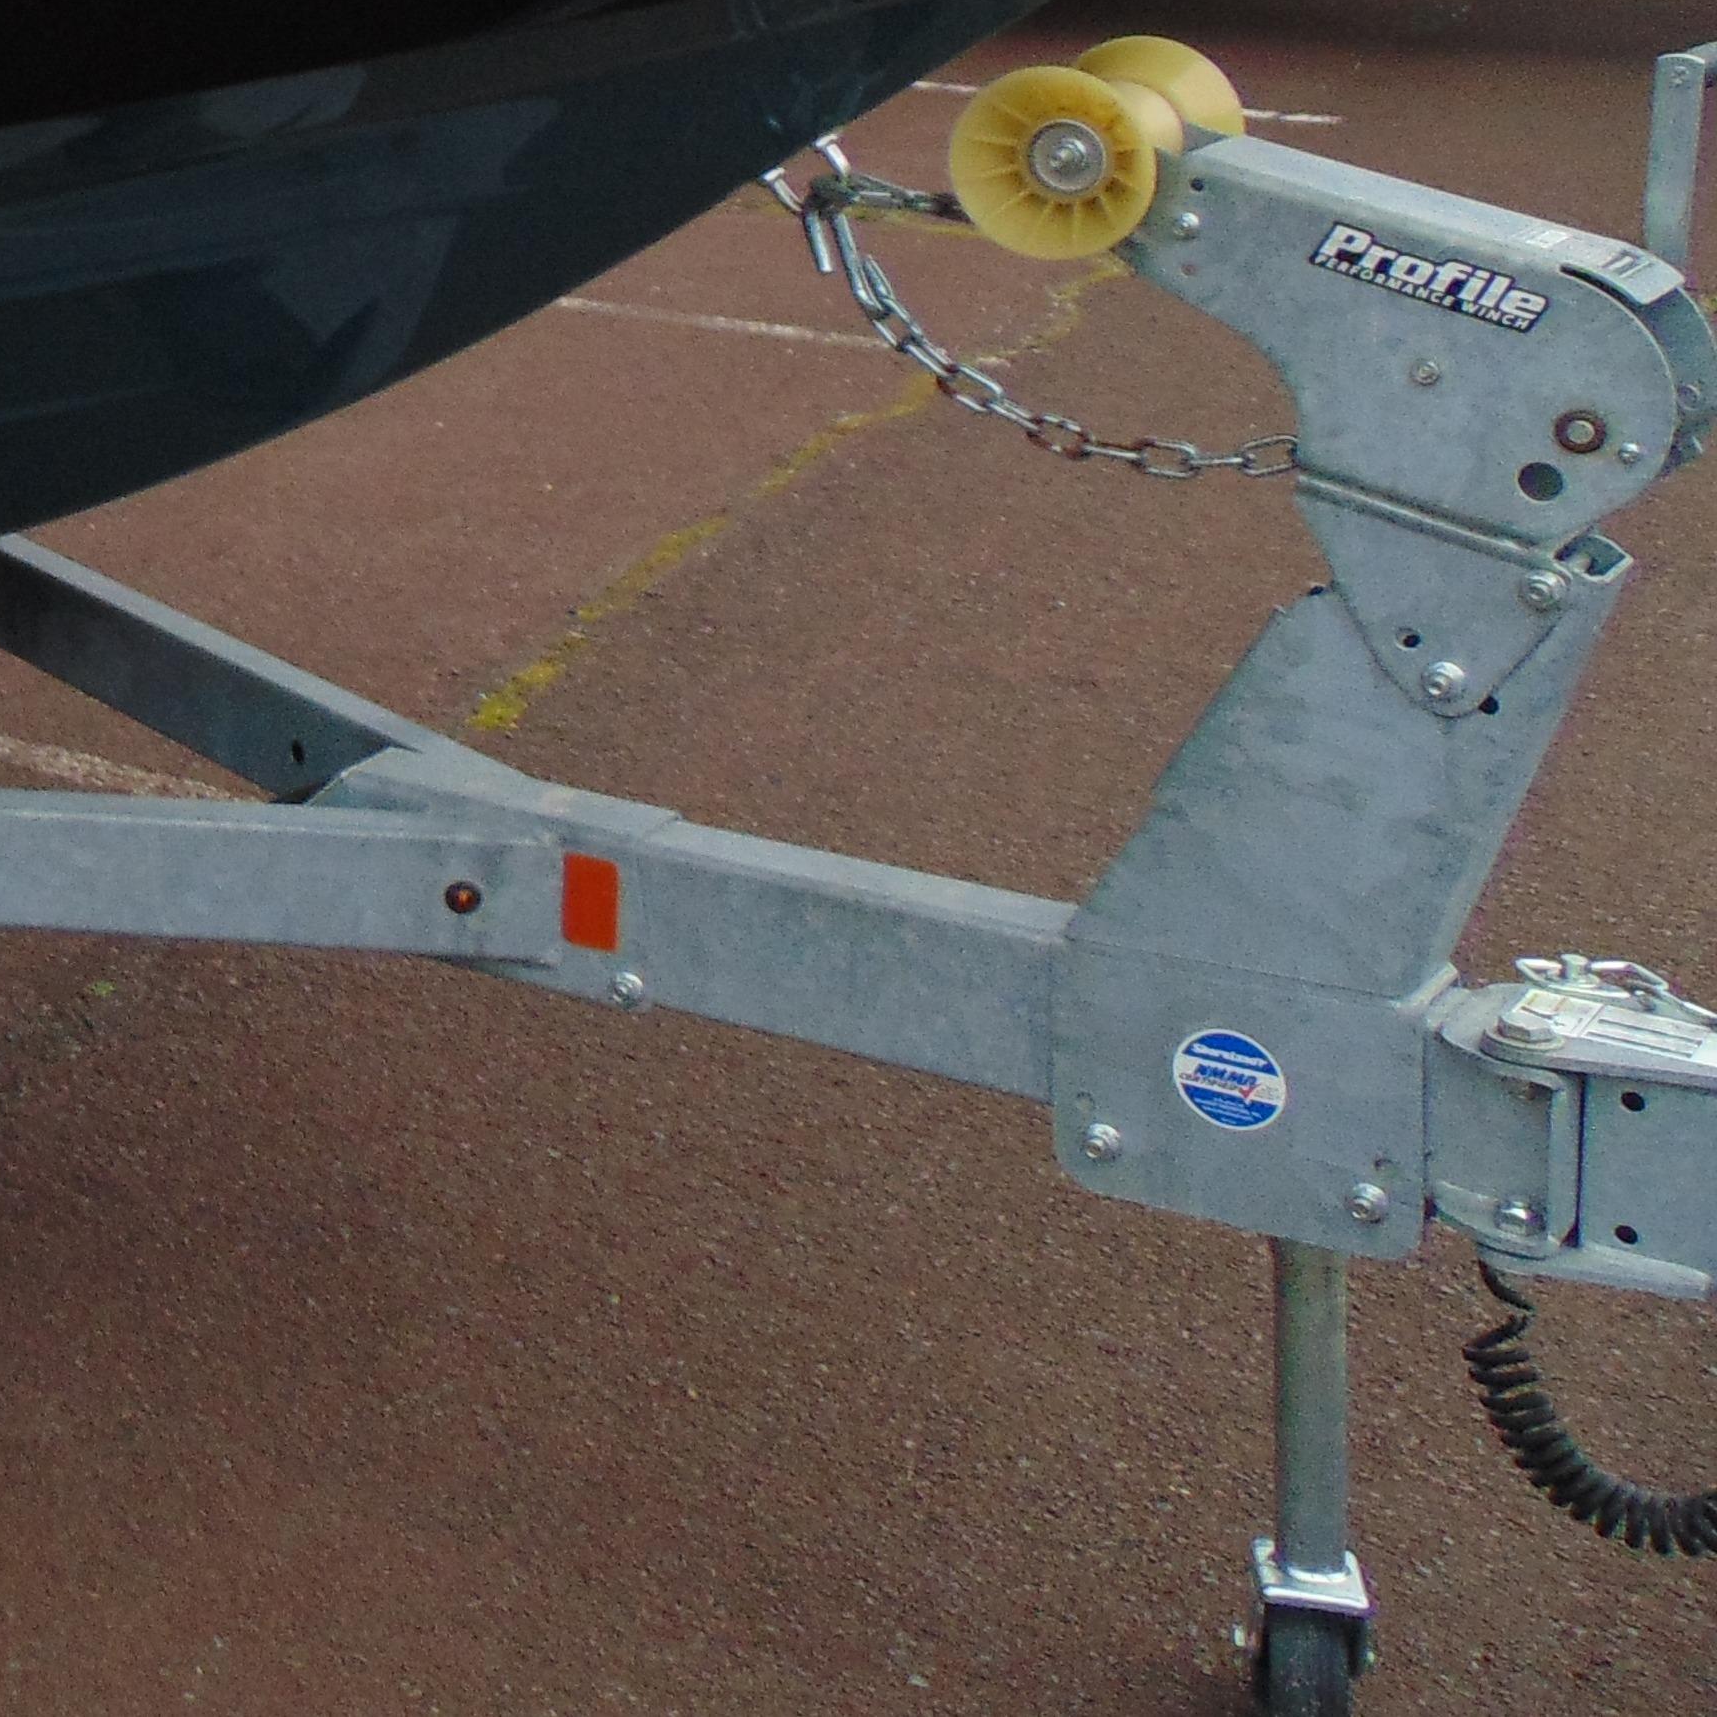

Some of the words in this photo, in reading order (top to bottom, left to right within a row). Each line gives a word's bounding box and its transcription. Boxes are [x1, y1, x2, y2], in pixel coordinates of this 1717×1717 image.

[1313, 254, 1456, 308] PERFORMANCE
[1460, 300, 1531, 331] WINCH
[1317, 223, 1547, 320] Profile
